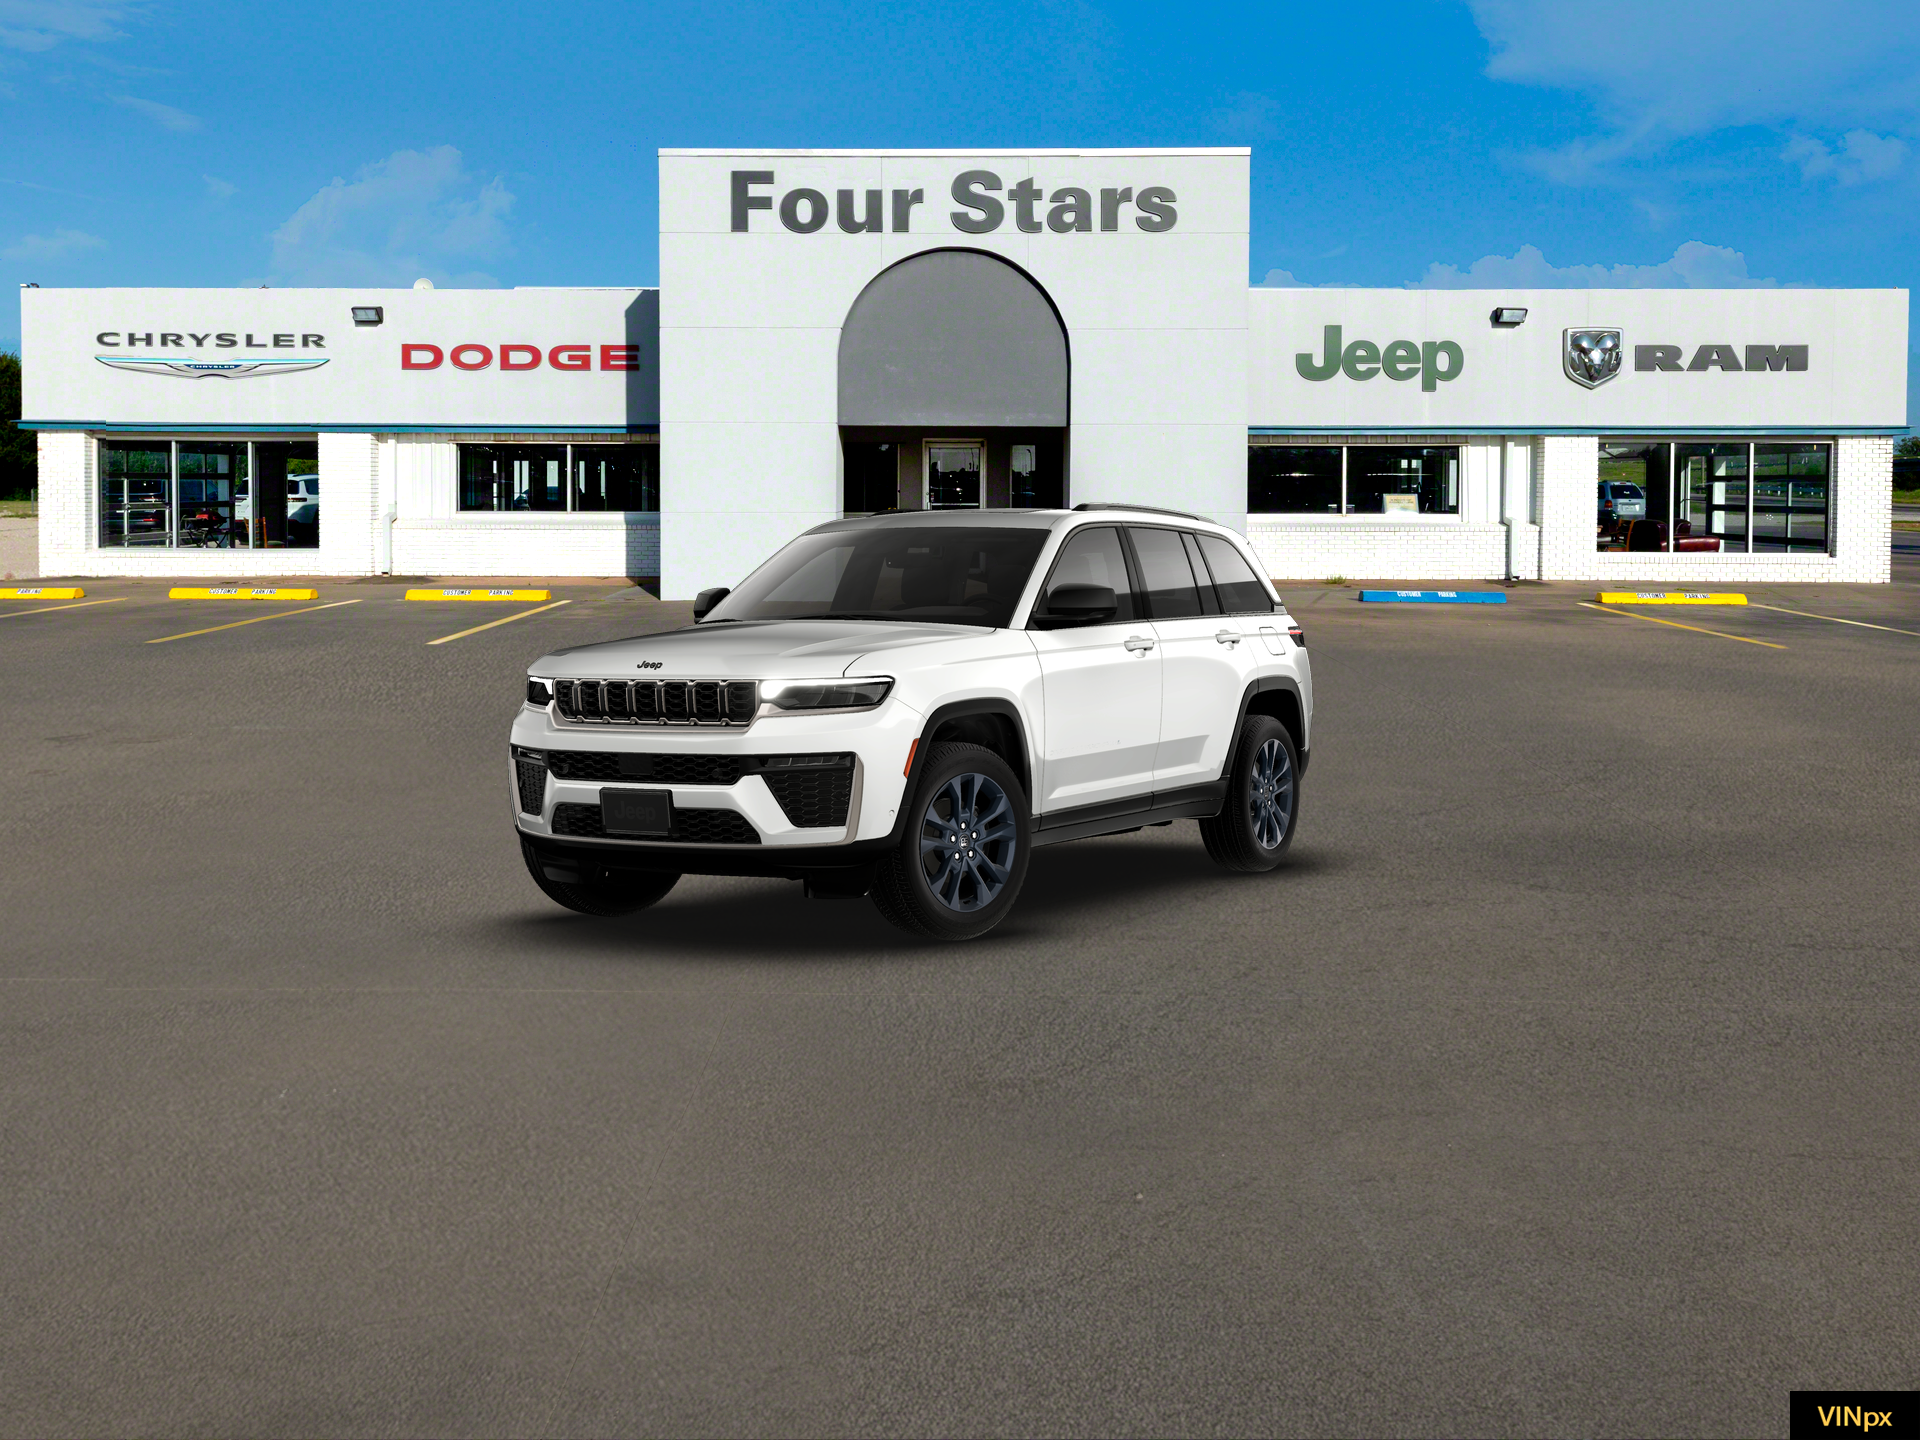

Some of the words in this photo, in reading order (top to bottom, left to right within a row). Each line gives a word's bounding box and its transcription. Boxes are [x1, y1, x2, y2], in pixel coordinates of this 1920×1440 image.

[731, 170, 924, 234] Four
[950, 169, 1178, 234] Stars
[96, 332, 326, 348] CHRYSLER
[401, 343, 640, 371] DODGE
[1296, 325, 1464, 392] Jeep
[1635, 344, 1809, 372] RAM
[636, 660, 663, 671] Jeep
[614, 800, 656, 824] Jeep
